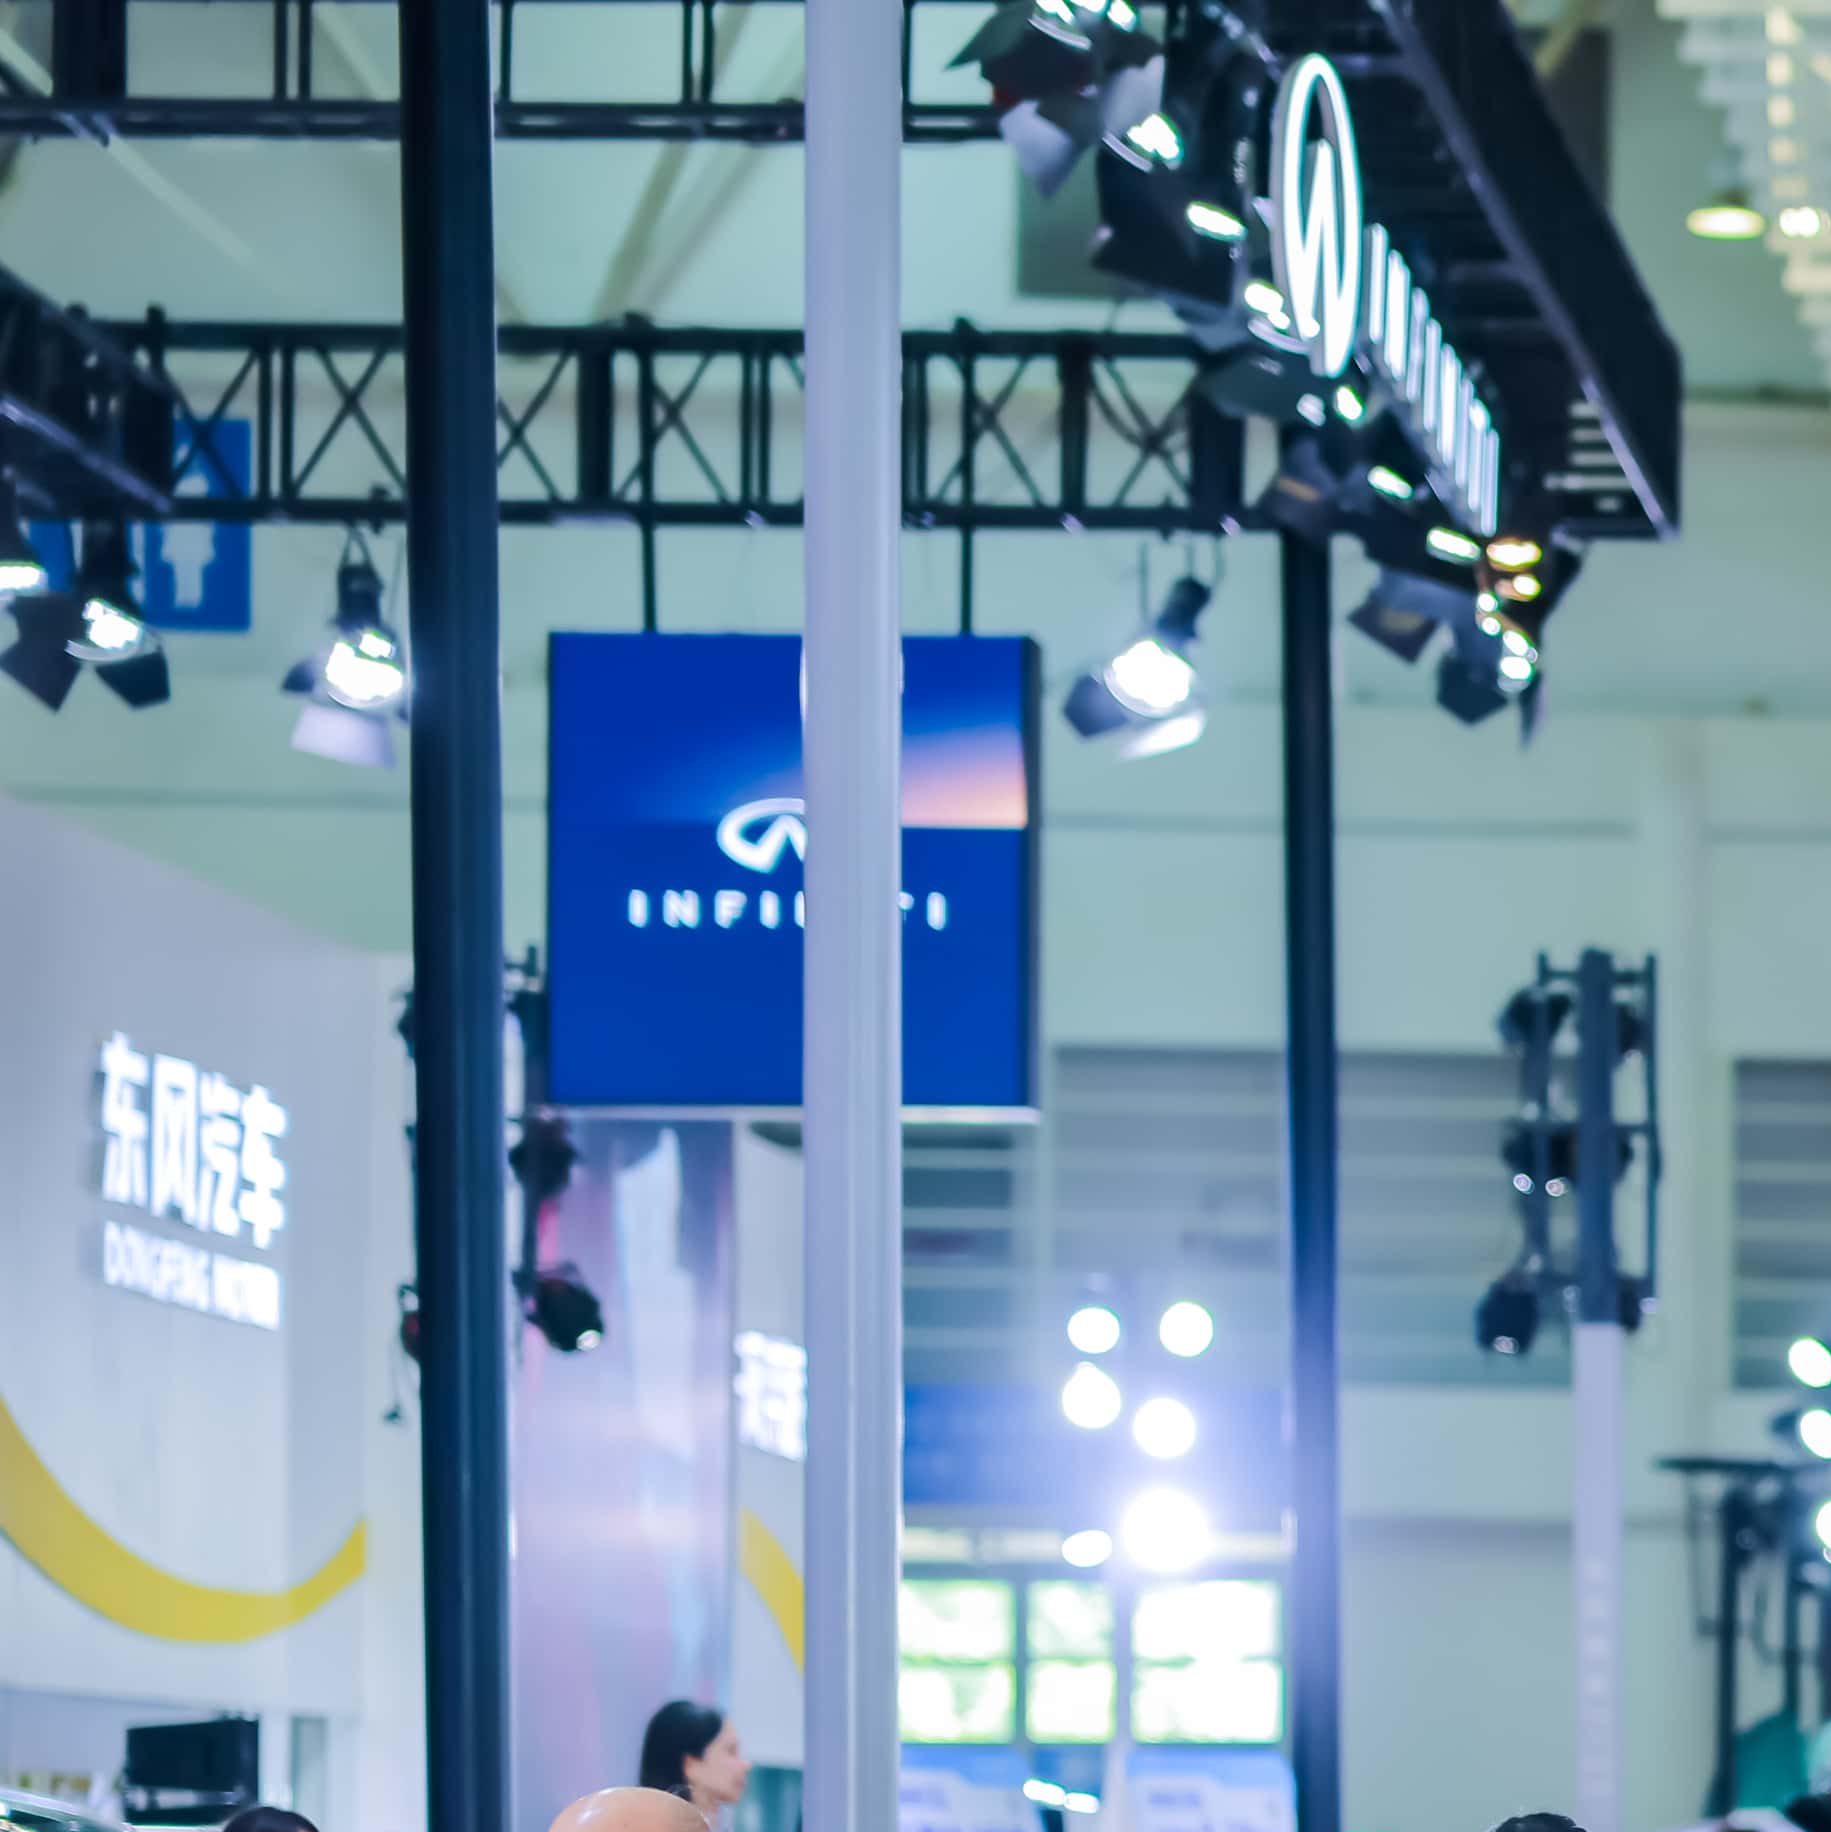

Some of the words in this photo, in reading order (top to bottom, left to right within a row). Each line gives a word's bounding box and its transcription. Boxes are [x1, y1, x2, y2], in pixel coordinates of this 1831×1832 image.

[628, 889, 948, 930] INFII
[101, 1030, 288, 1250] 东风汽车
